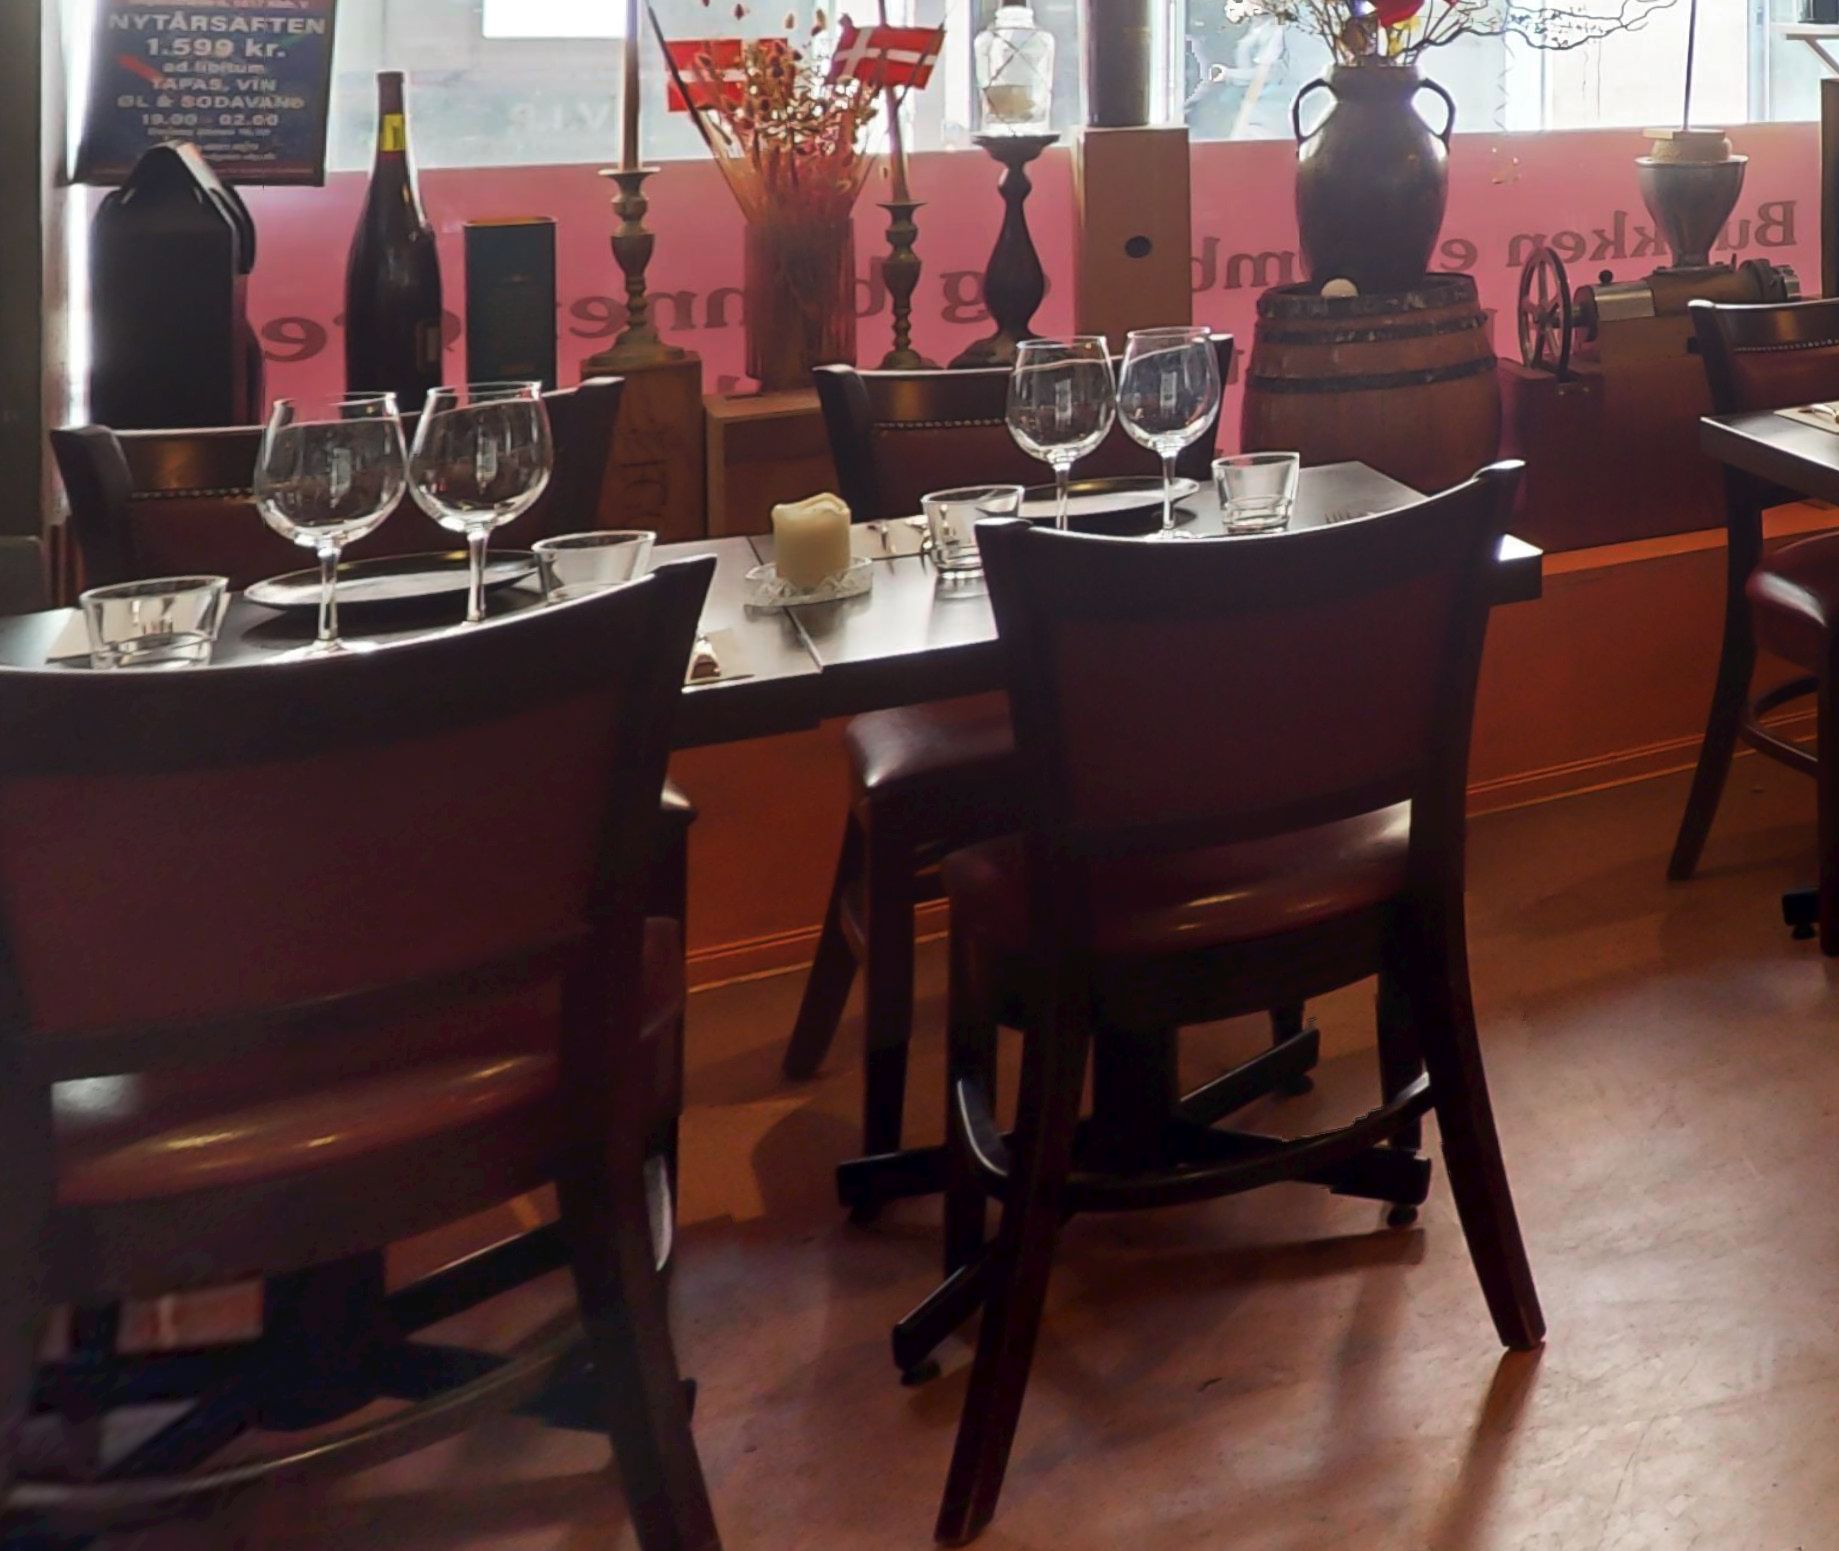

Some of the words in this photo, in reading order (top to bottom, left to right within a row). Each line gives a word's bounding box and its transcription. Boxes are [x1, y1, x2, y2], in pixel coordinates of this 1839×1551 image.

[109, 12, 327, 34] NYTÅRSAFTEN
[146, 37, 235, 56] 1.599
[245, 38, 286, 58] kr.
[236, 77, 277, 92] VIN
